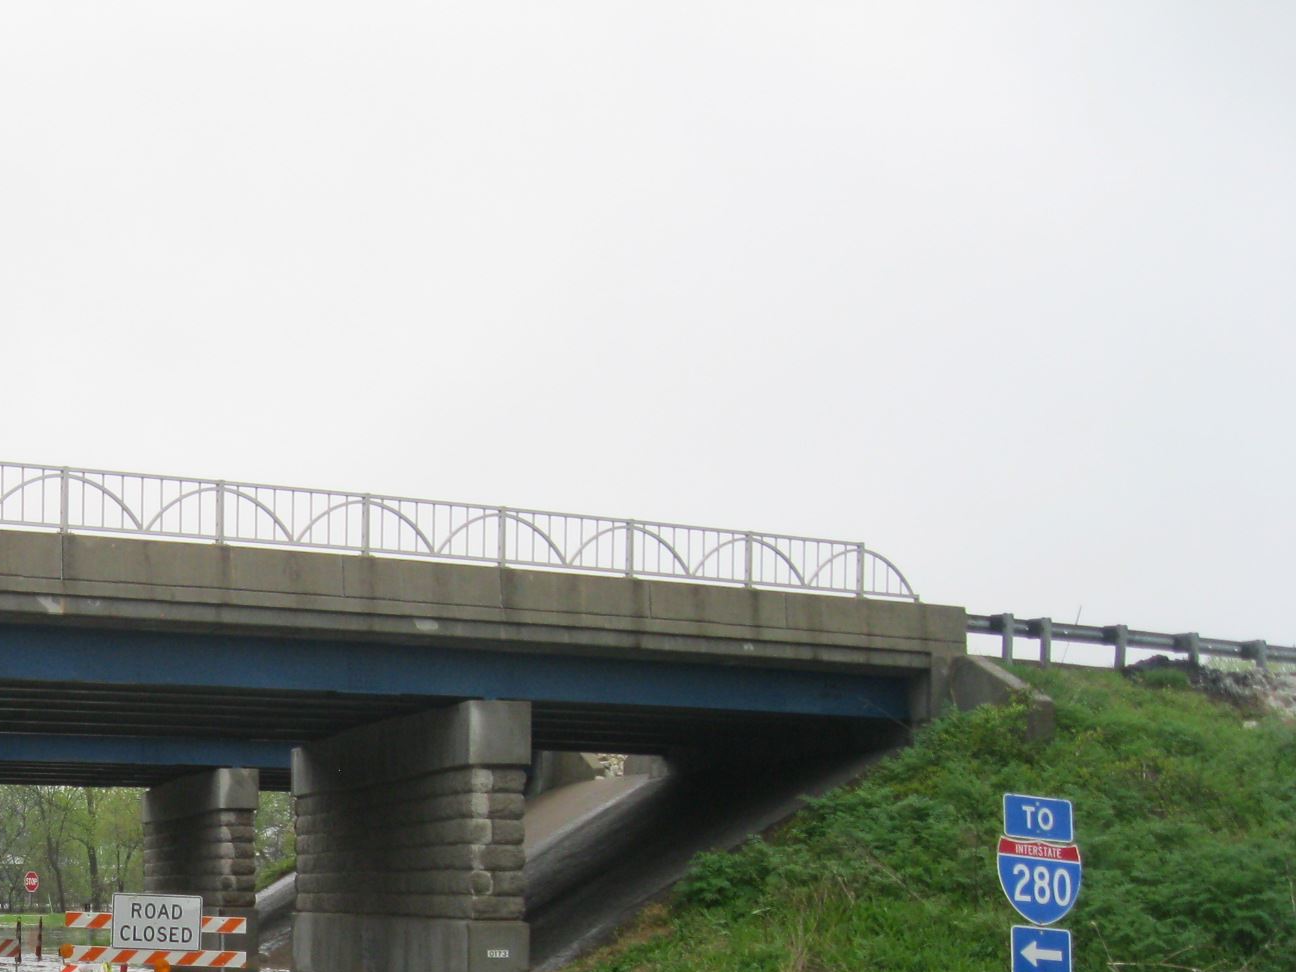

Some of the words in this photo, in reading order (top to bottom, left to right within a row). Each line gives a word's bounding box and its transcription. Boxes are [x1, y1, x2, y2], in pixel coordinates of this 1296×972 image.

[1021, 805, 1054, 831] TO
[1015, 844, 1063, 859] INTERSTATE
[25, 877, 38, 885] STOP
[1012, 863, 1072, 907] 280
[131, 902, 183, 920] ROAD
[120, 925, 193, 943] CLOSED
